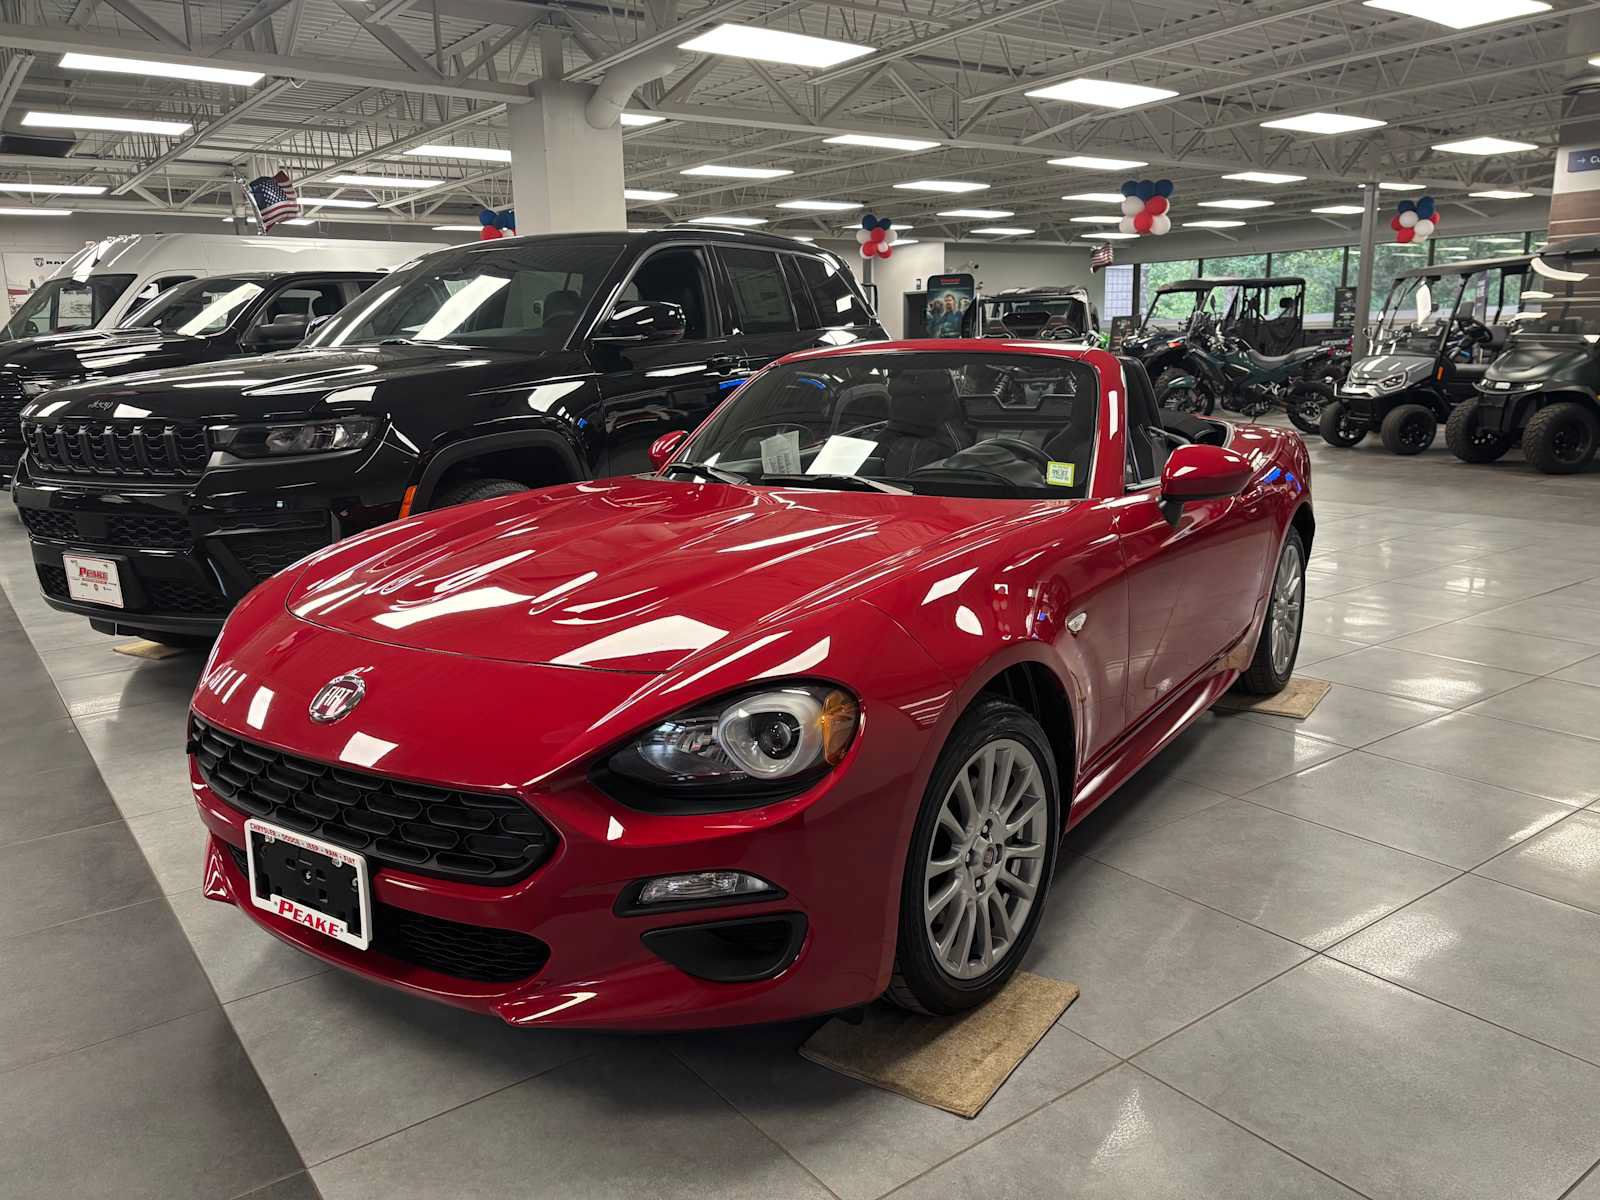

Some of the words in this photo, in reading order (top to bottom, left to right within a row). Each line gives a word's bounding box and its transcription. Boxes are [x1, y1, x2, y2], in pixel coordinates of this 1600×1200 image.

[88, 400, 114, 411] Jeep
[313, 686, 354, 714] FIAT
[249, 823, 276, 836] CHRYSLER
[281, 834, 301, 846] DODGE
[306, 842, 320, 852] JEEP
[325, 848, 338, 858] RAM
[343, 855, 356, 864] FIAT
[278, 899, 340, 937] PEAKE
